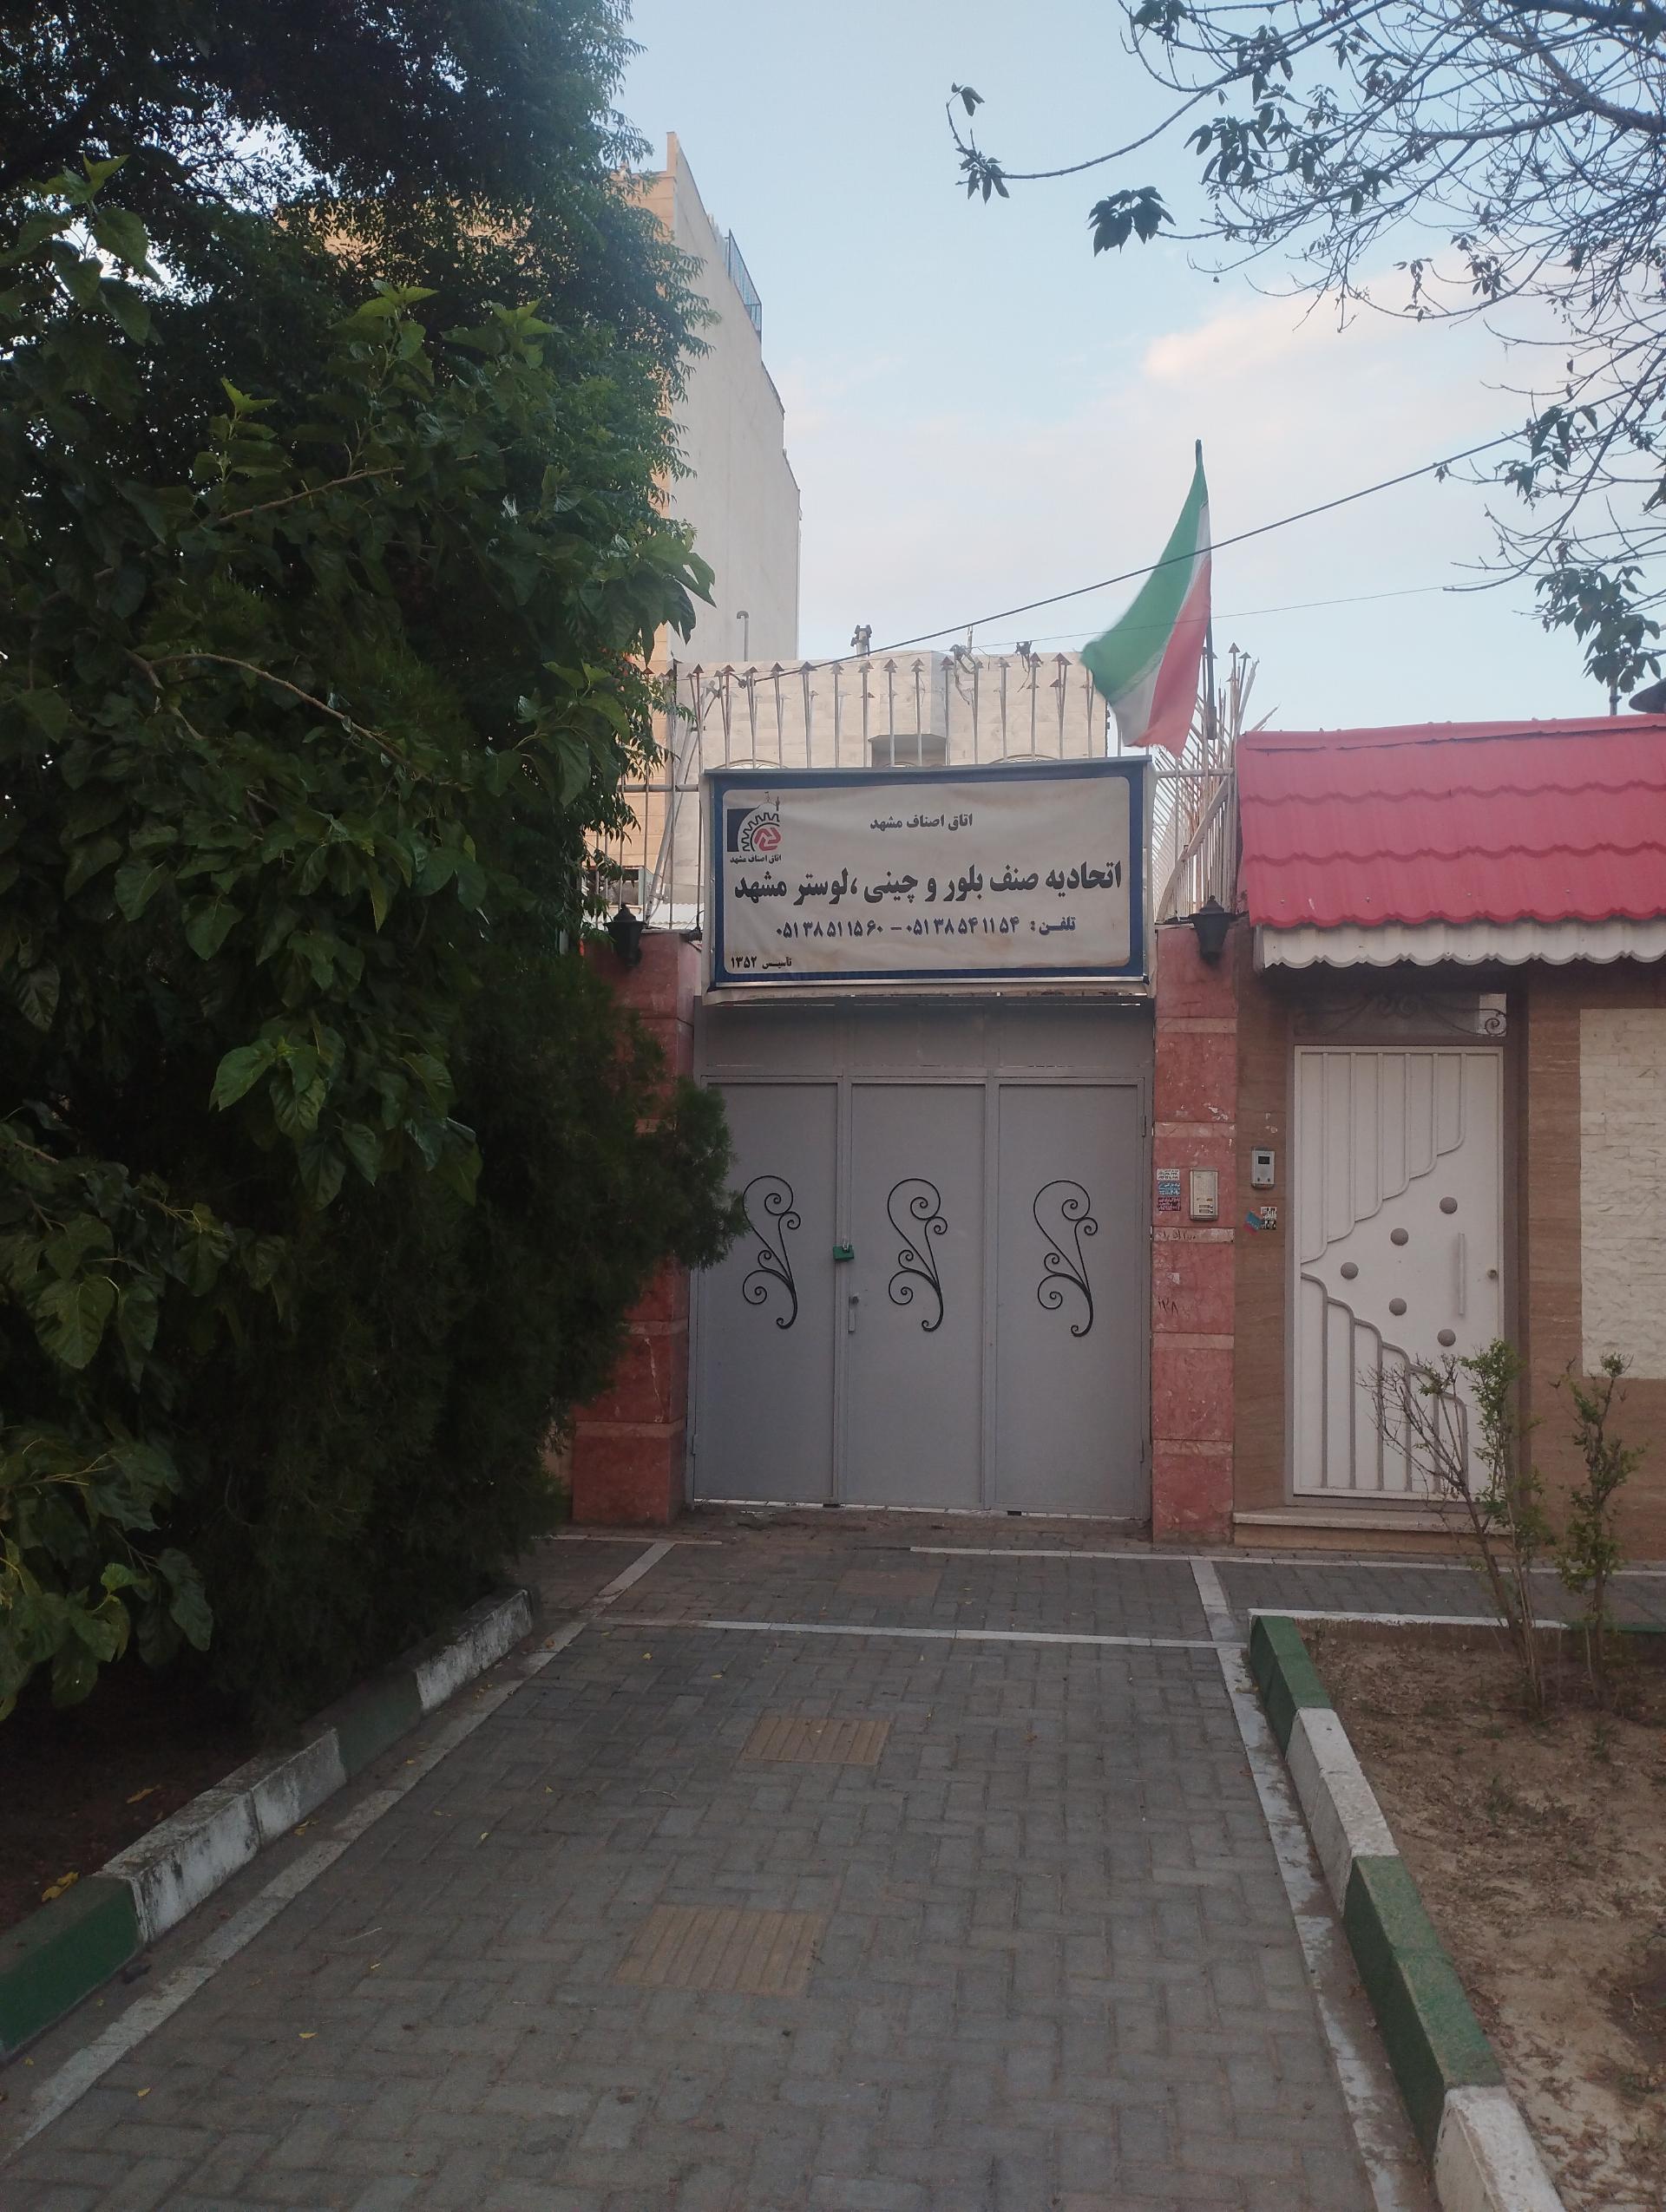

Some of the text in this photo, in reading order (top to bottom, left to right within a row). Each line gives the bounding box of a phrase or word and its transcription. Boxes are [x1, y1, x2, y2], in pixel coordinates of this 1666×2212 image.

[869, 813, 974, 832] اتاق اصناف مشهد
[729, 854, 747, 865] مشهد
[747, 854, 768, 863] اصناف
[734, 870, 788, 904] مشهد
[863, 870, 919, 904] چینی
[924, 877, 937, 903] و
[942, 863, 984, 902] بلور
[989, 864, 1040, 893] صنف
[1045, 860, 1122, 899] اتحادیه
[731, 955, 758, 969] ۱۳۵۲
